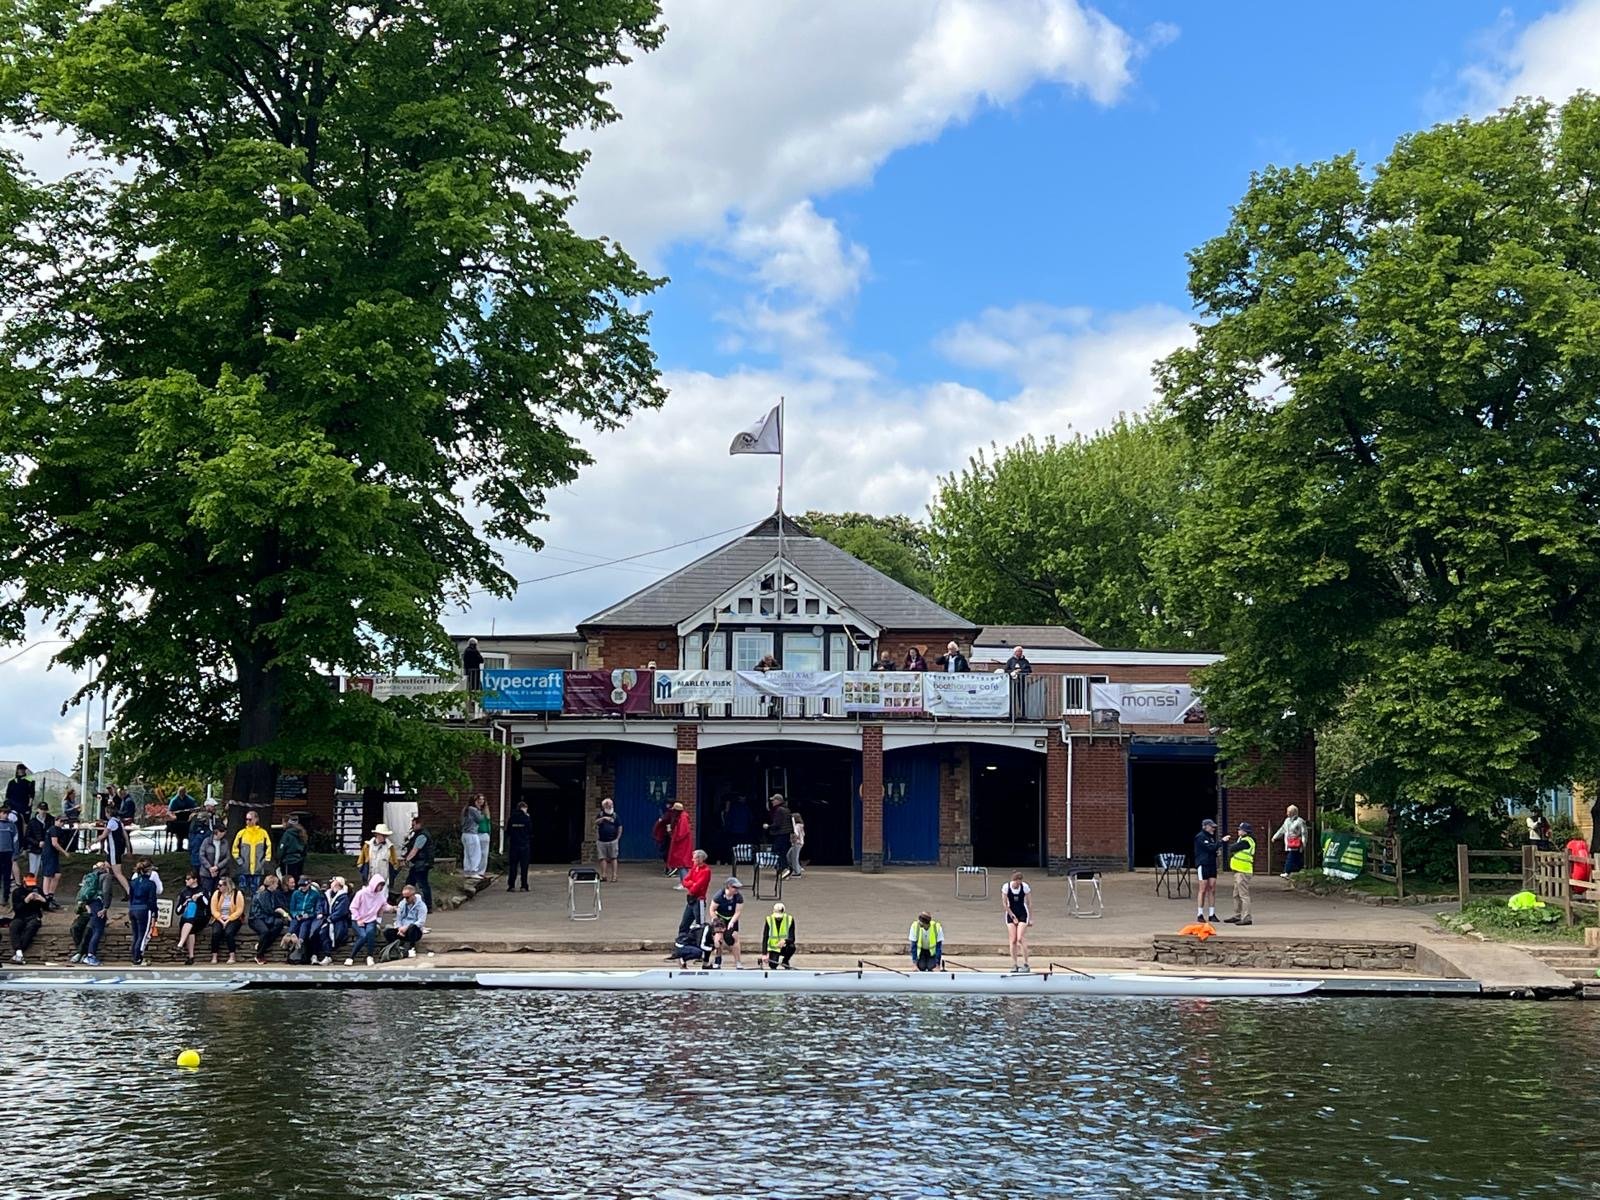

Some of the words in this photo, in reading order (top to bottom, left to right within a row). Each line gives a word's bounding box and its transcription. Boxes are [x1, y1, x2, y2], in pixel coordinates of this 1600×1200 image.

[484, 673, 562, 691] typecraft
[979, 682, 999, 691] café
[1121, 695, 1178, 707] monssi
